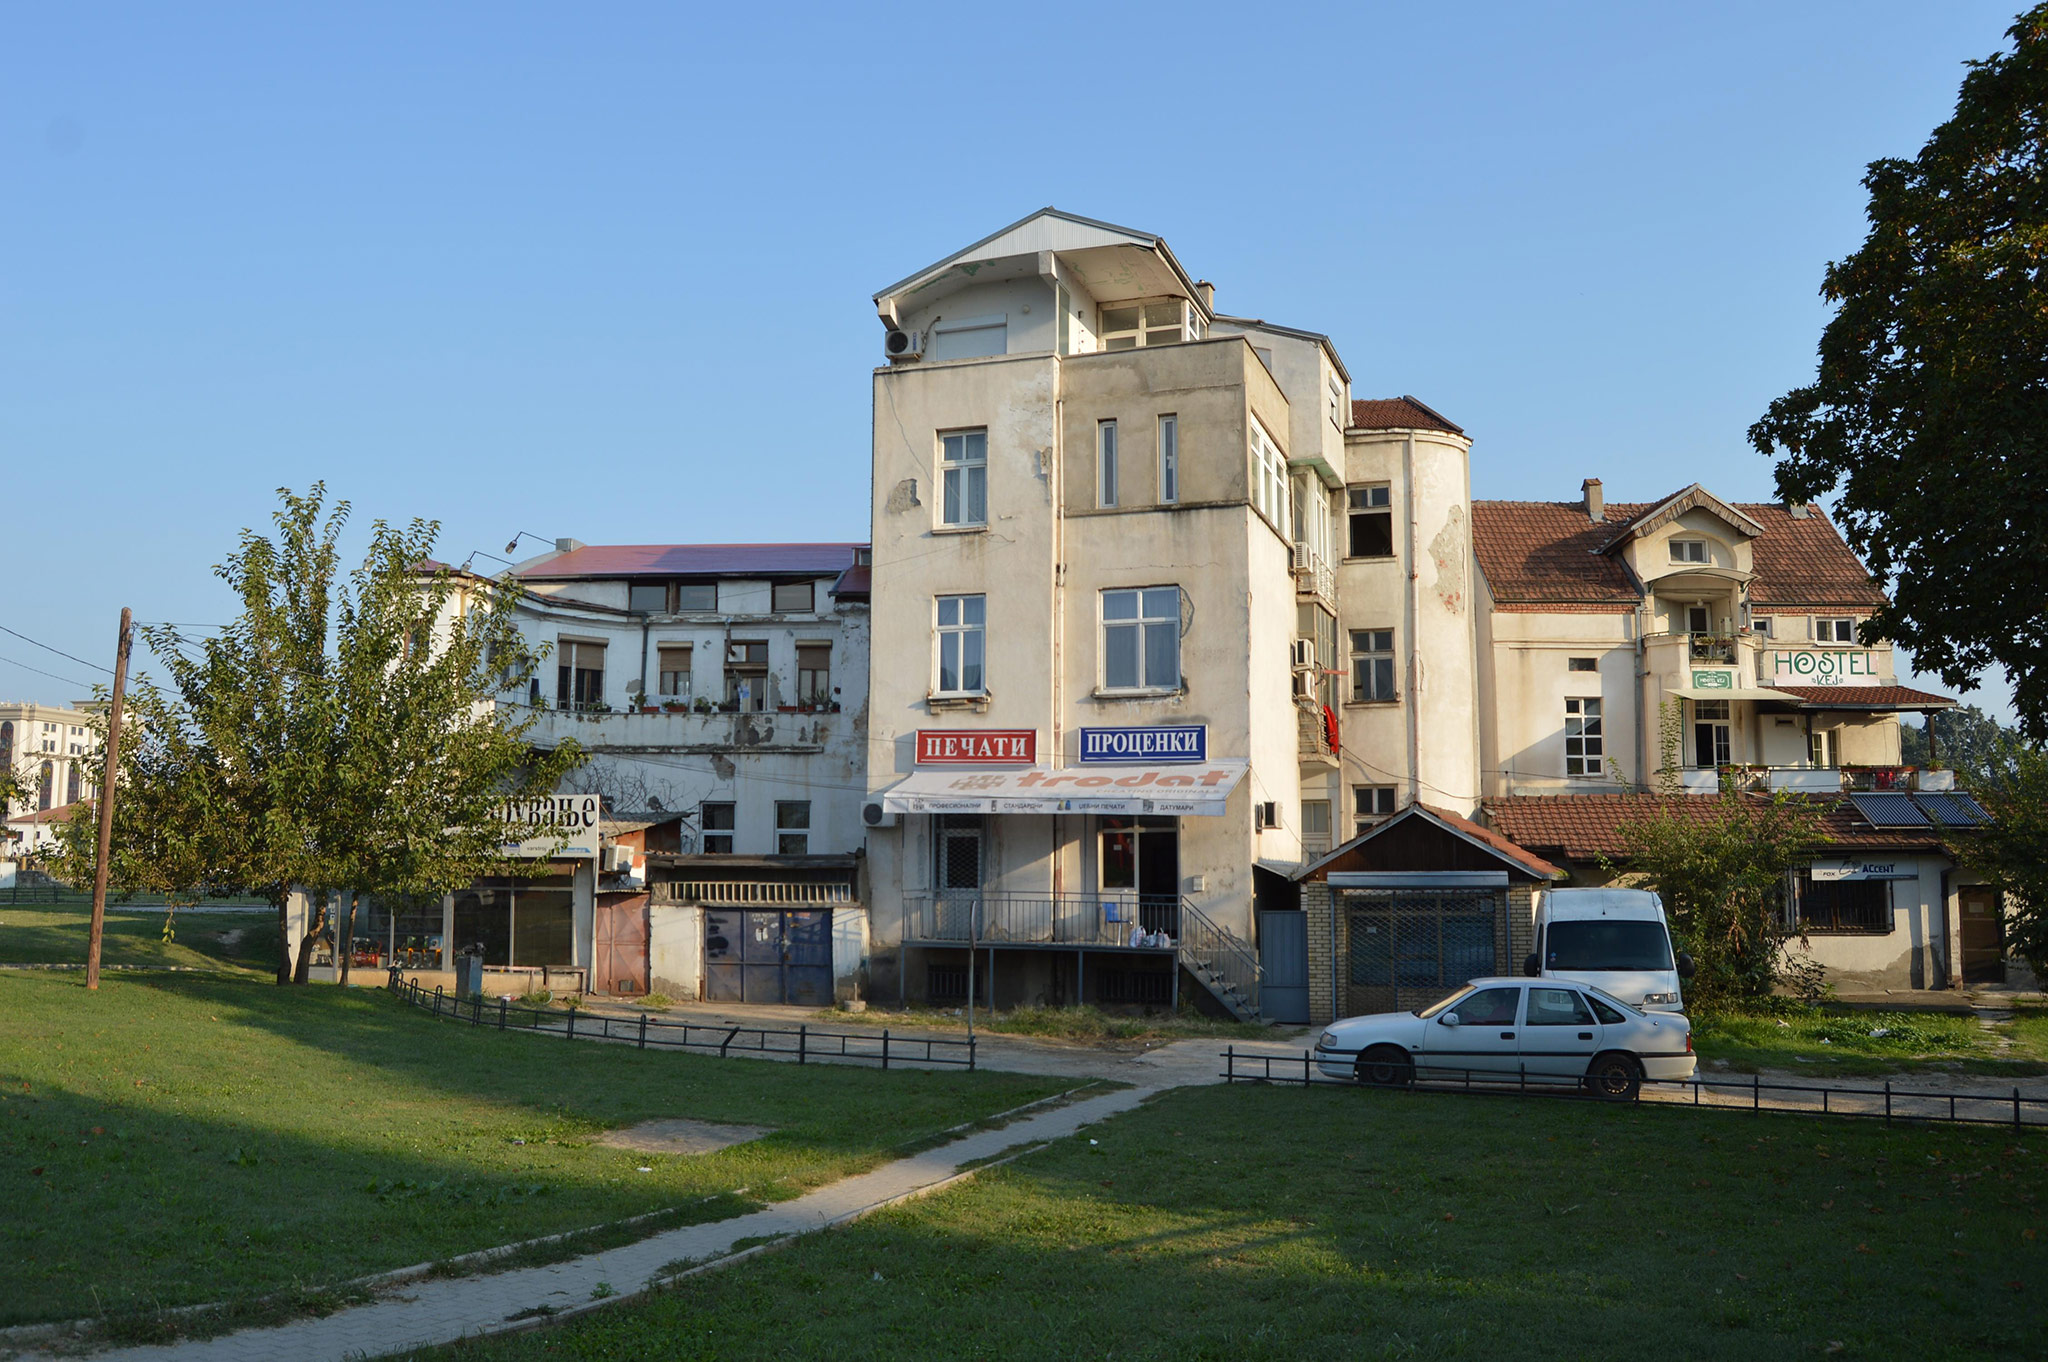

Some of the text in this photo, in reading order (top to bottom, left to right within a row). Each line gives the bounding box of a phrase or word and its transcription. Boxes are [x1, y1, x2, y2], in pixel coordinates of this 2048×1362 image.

[1774, 651, 1878, 675] HOSTEL
[1816, 675, 1838, 686] KEJ
[925, 737, 1028, 757] ПЕЧАТИ
[1086, 731, 1199, 757] ПРОЦЕНКИ
[1016, 770, 1229, 788] trodat
